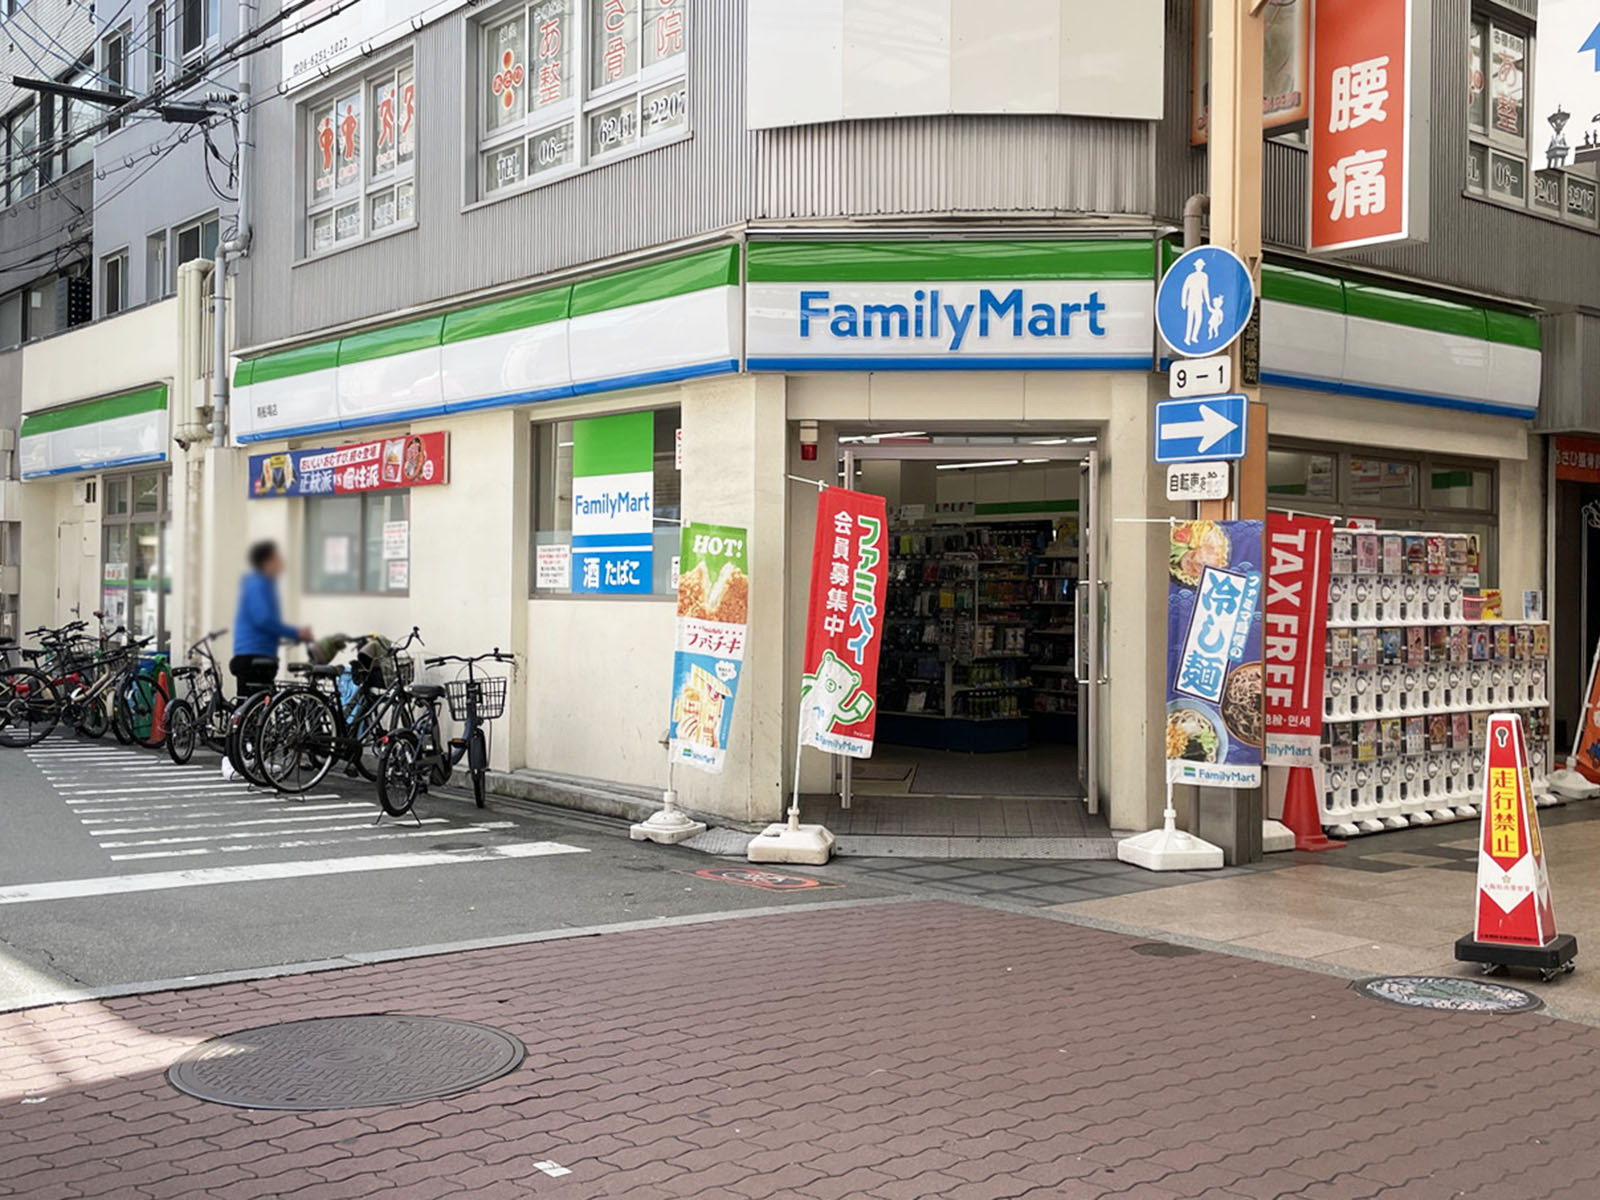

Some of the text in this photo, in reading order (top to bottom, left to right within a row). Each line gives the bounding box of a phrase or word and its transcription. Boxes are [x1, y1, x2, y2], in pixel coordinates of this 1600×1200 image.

[497, 154, 520, 182] TEL
[540, 137, 564, 165] 06-
[600, 113, 633, 145] 6241
[1327, 55, 1390, 222] 腰痛
[799, 288, 1106, 351] FamilyMart
[575, 491, 650, 519] FamilyMart
[583, 557, 601, 588] 酒
[605, 559, 640, 586] たばこ
[692, 533, 743, 559] HOT!
[823, 510, 854, 638] 会員募集中
[847, 514, 881, 666] ファミペイ
[1265, 528, 1306, 708] TAX FREE
[686, 632, 742, 655] ファミチキ
[1181, 571, 1241, 698] 冷し麺
[1198, 768, 1257, 784] FamilyMart
[1493, 770, 1518, 853] 走行禁止
